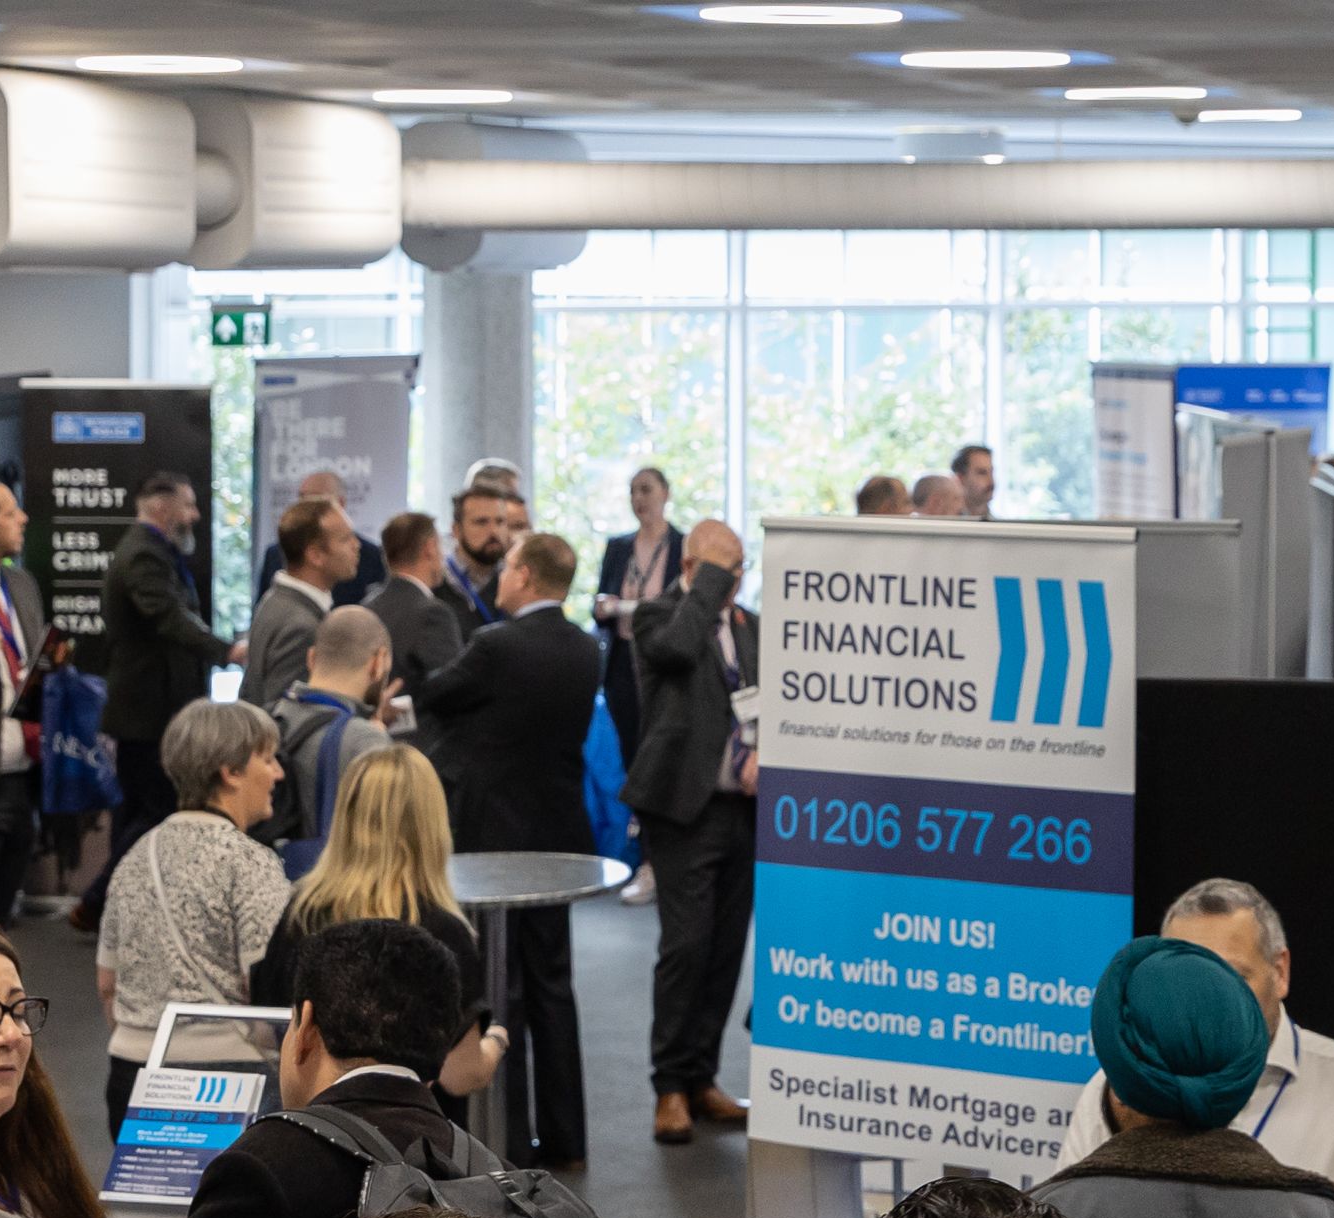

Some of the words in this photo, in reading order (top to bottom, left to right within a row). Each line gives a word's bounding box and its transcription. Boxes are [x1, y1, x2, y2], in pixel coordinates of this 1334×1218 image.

[52, 468, 108, 486] MORE
[52, 487, 127, 508] TRUST
[52, 532, 100, 550] LESS
[52, 551, 115, 571] CRIM
[783, 571, 978, 609] FRONTLINE
[782, 621, 966, 660] FINANCIAL
[781, 671, 978, 713] SOLUTIONS
[778, 720, 841, 740] financial
[842, 726, 911, 745] solutions
[915, 729, 938, 746] for
[941, 732, 982, 750] those
[986, 738, 1006, 752] on
[1010, 737, 1036, 754] the
[1039, 738, 1106, 759] frontline
[773, 794, 902, 850] 01206
[915, 807, 995, 857] 577
[1007, 814, 1093, 865] 266
[874, 912, 941, 944] JOIN
[949, 918, 995, 949] US!
[769, 947, 834, 981] Work
[840, 957, 898, 987] with
[905, 968, 939, 992] us
[946, 973, 977, 996] as
[984, 977, 1001, 999] a
[1007, 972, 1095, 1008] Broke
[778, 995, 809, 1025] Or
[815, 1000, 922, 1037] become
[929, 1017, 946, 1040] a
[769, 1068, 898, 1106] Specialist
[909, 1086, 1037, 1127] Mortgage
[798, 1104, 933, 1142] Insurance
[942, 1122, 1063, 1160] Advicers
